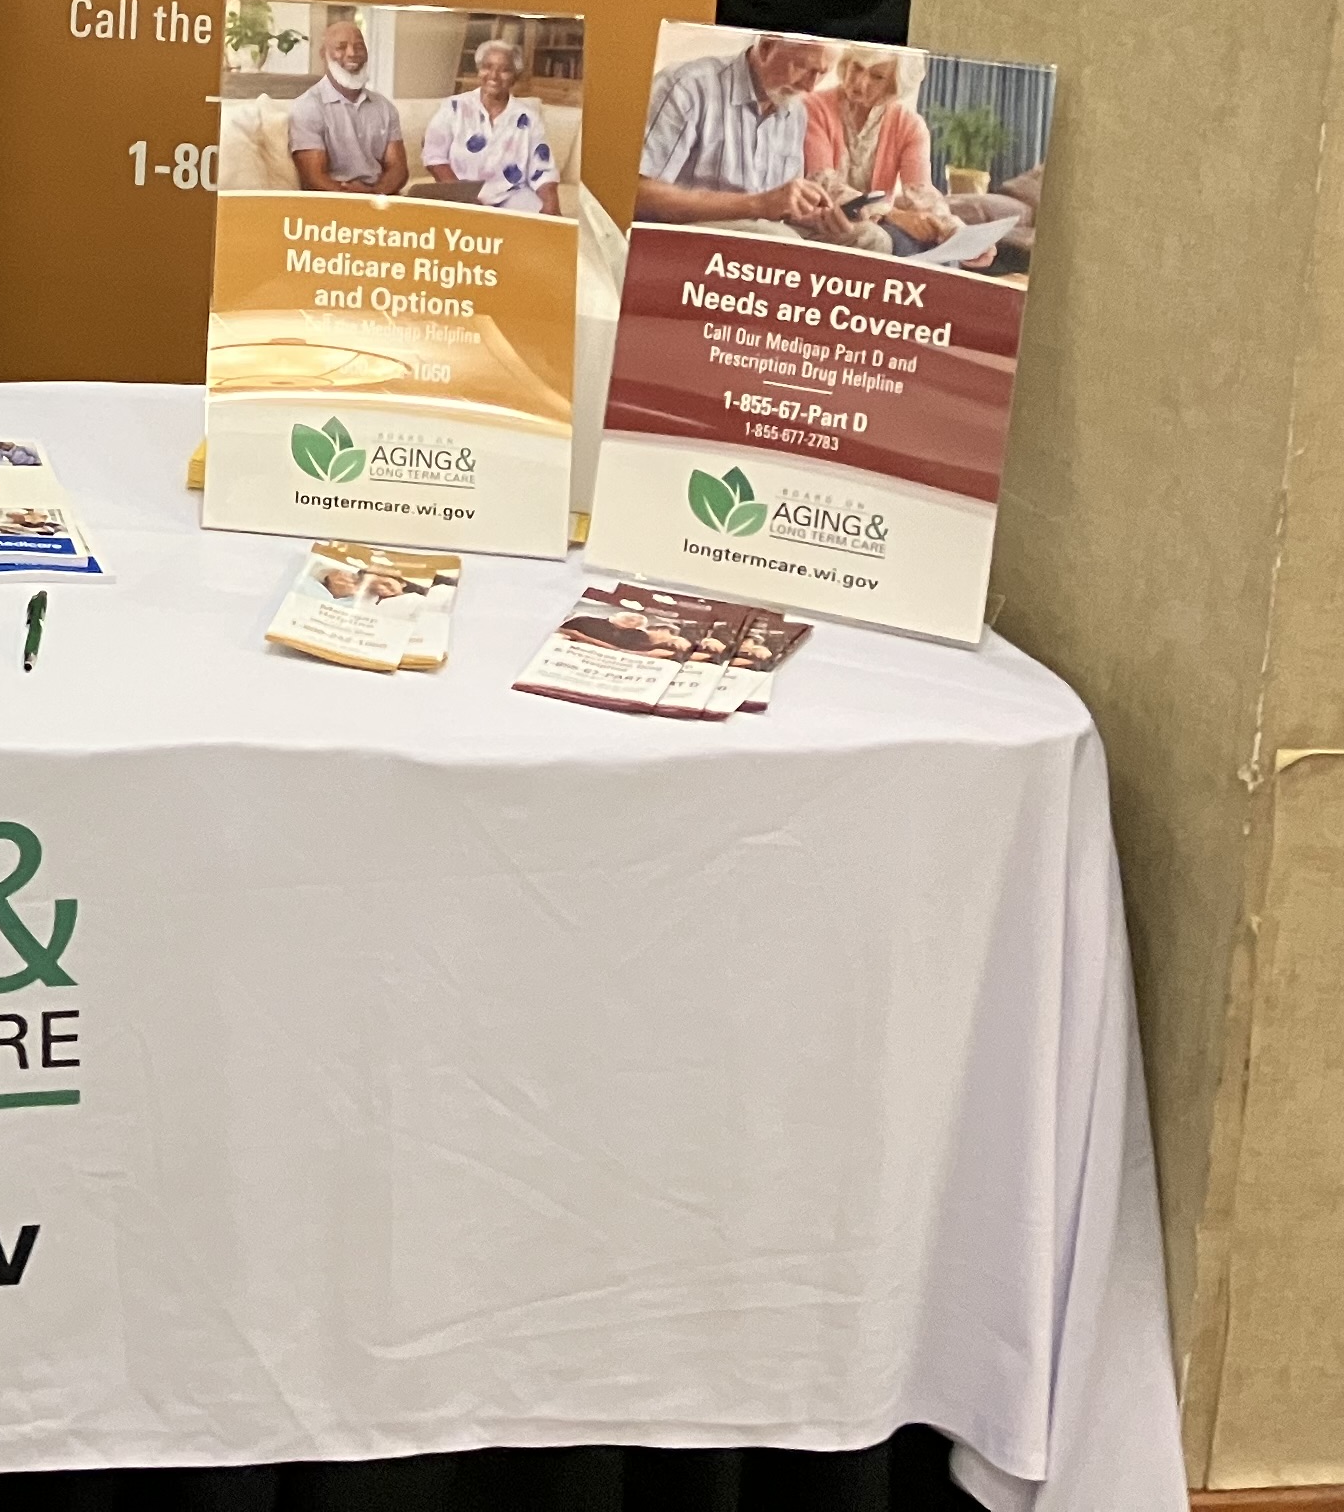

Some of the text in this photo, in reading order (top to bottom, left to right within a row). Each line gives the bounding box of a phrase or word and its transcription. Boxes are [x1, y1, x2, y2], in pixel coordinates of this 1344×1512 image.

[152, 1, 212, 46] the
[283, 217, 503, 256] Understand Your
[286, 249, 498, 290] Medicare Rights
[705, 252, 928, 308] Assure your RX
[314, 286, 475, 318] and Options
[681, 281, 952, 348] Needs are Covered
[425, 323, 481, 345] Helpline
[703, 322, 918, 374] Call Our Medigap Part D and
[709, 345, 905, 395] Prescription Drug Helpline
[723, 390, 868, 433] 1-855-67-Part D
[745, 421, 840, 452] 1-855-677-2783
[369, 467, 476, 485] LONG TERM CARE
[371, 445, 476, 473] AGING &
[295, 491, 476, 521] longtermcare.wi.gov
[772, 502, 889, 541] AGING &
[769, 520, 886, 554] LONG TERM CARE
[683, 538, 879, 590] longtermcare.wi.gov
